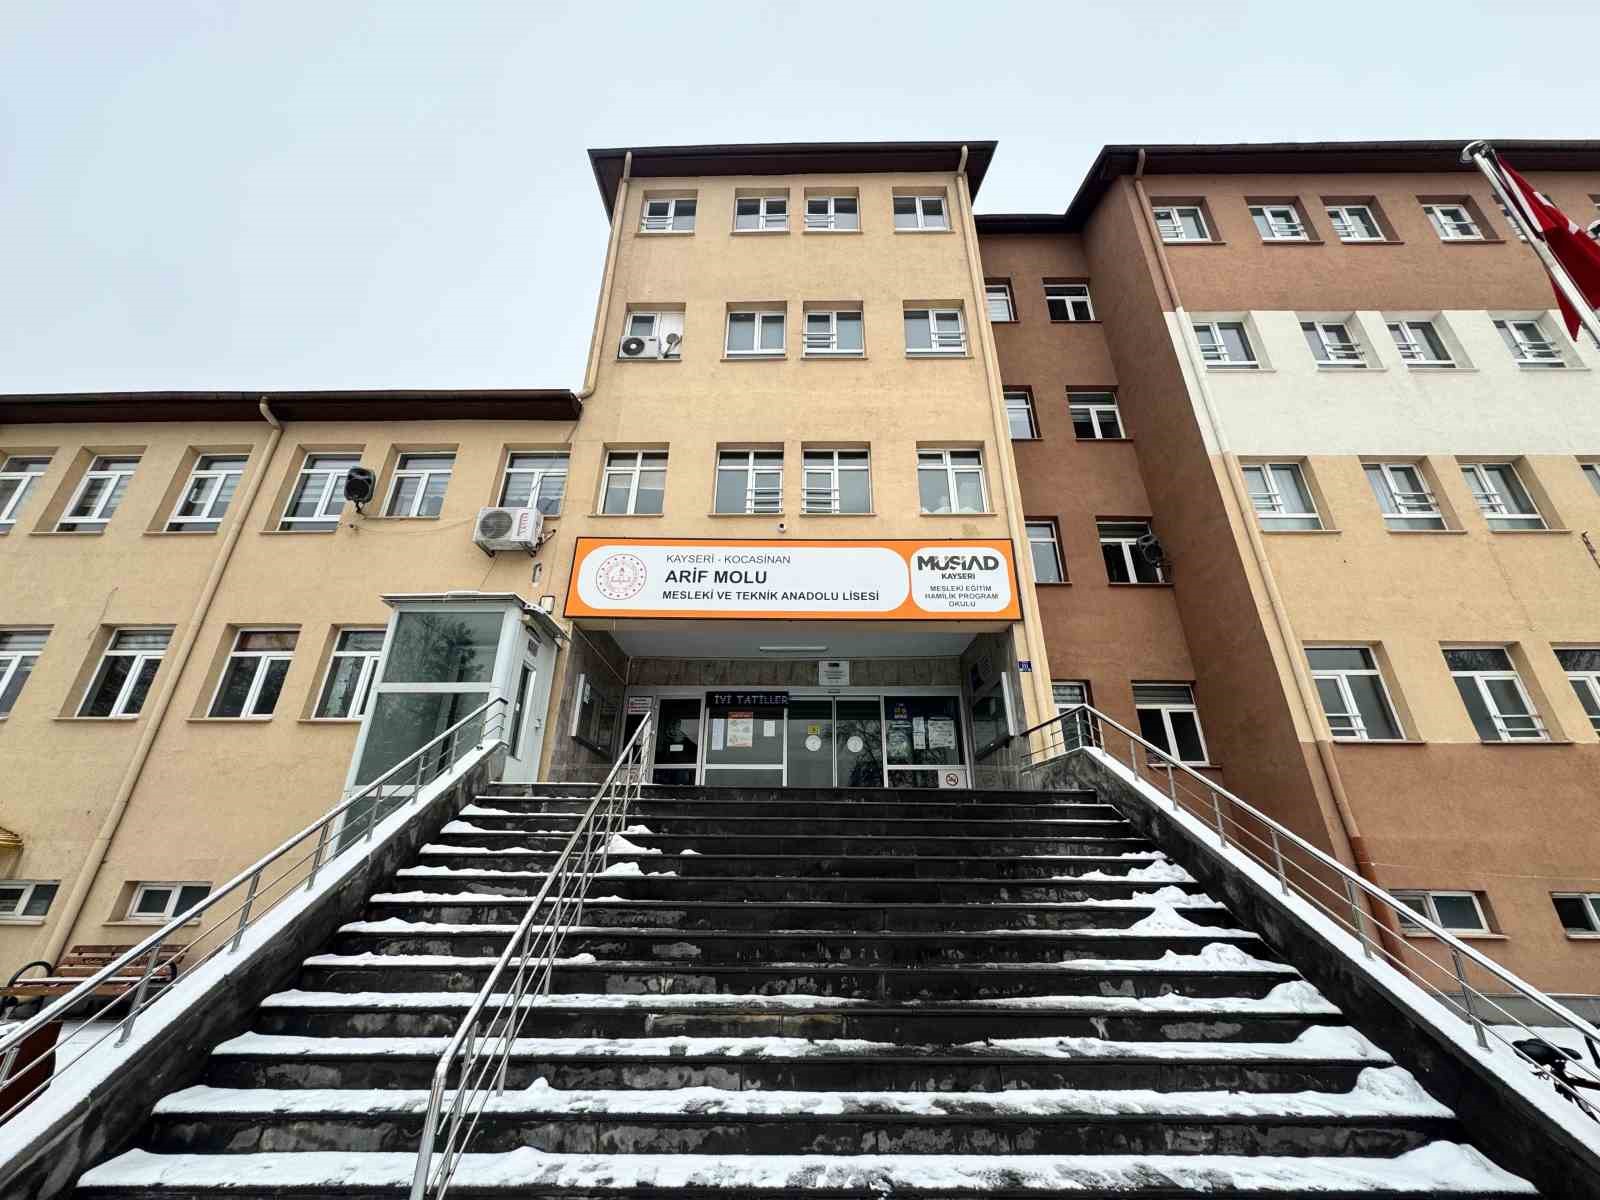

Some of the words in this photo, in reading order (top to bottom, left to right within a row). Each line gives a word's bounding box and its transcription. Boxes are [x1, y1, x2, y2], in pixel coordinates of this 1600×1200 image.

[666, 553, 714, 564] KAYSERİ
[724, 553, 791, 565] KOCASİNAN
[665, 567, 709, 584] ARİF
[713, 570, 768, 585] MOLU
[662, 589, 714, 601] MESLEKİ
[717, 591, 732, 601] VE
[735, 589, 778, 601] TEKNİK
[780, 591, 839, 602] ANADOLU
[842, 589, 880, 602] LİSESİ
